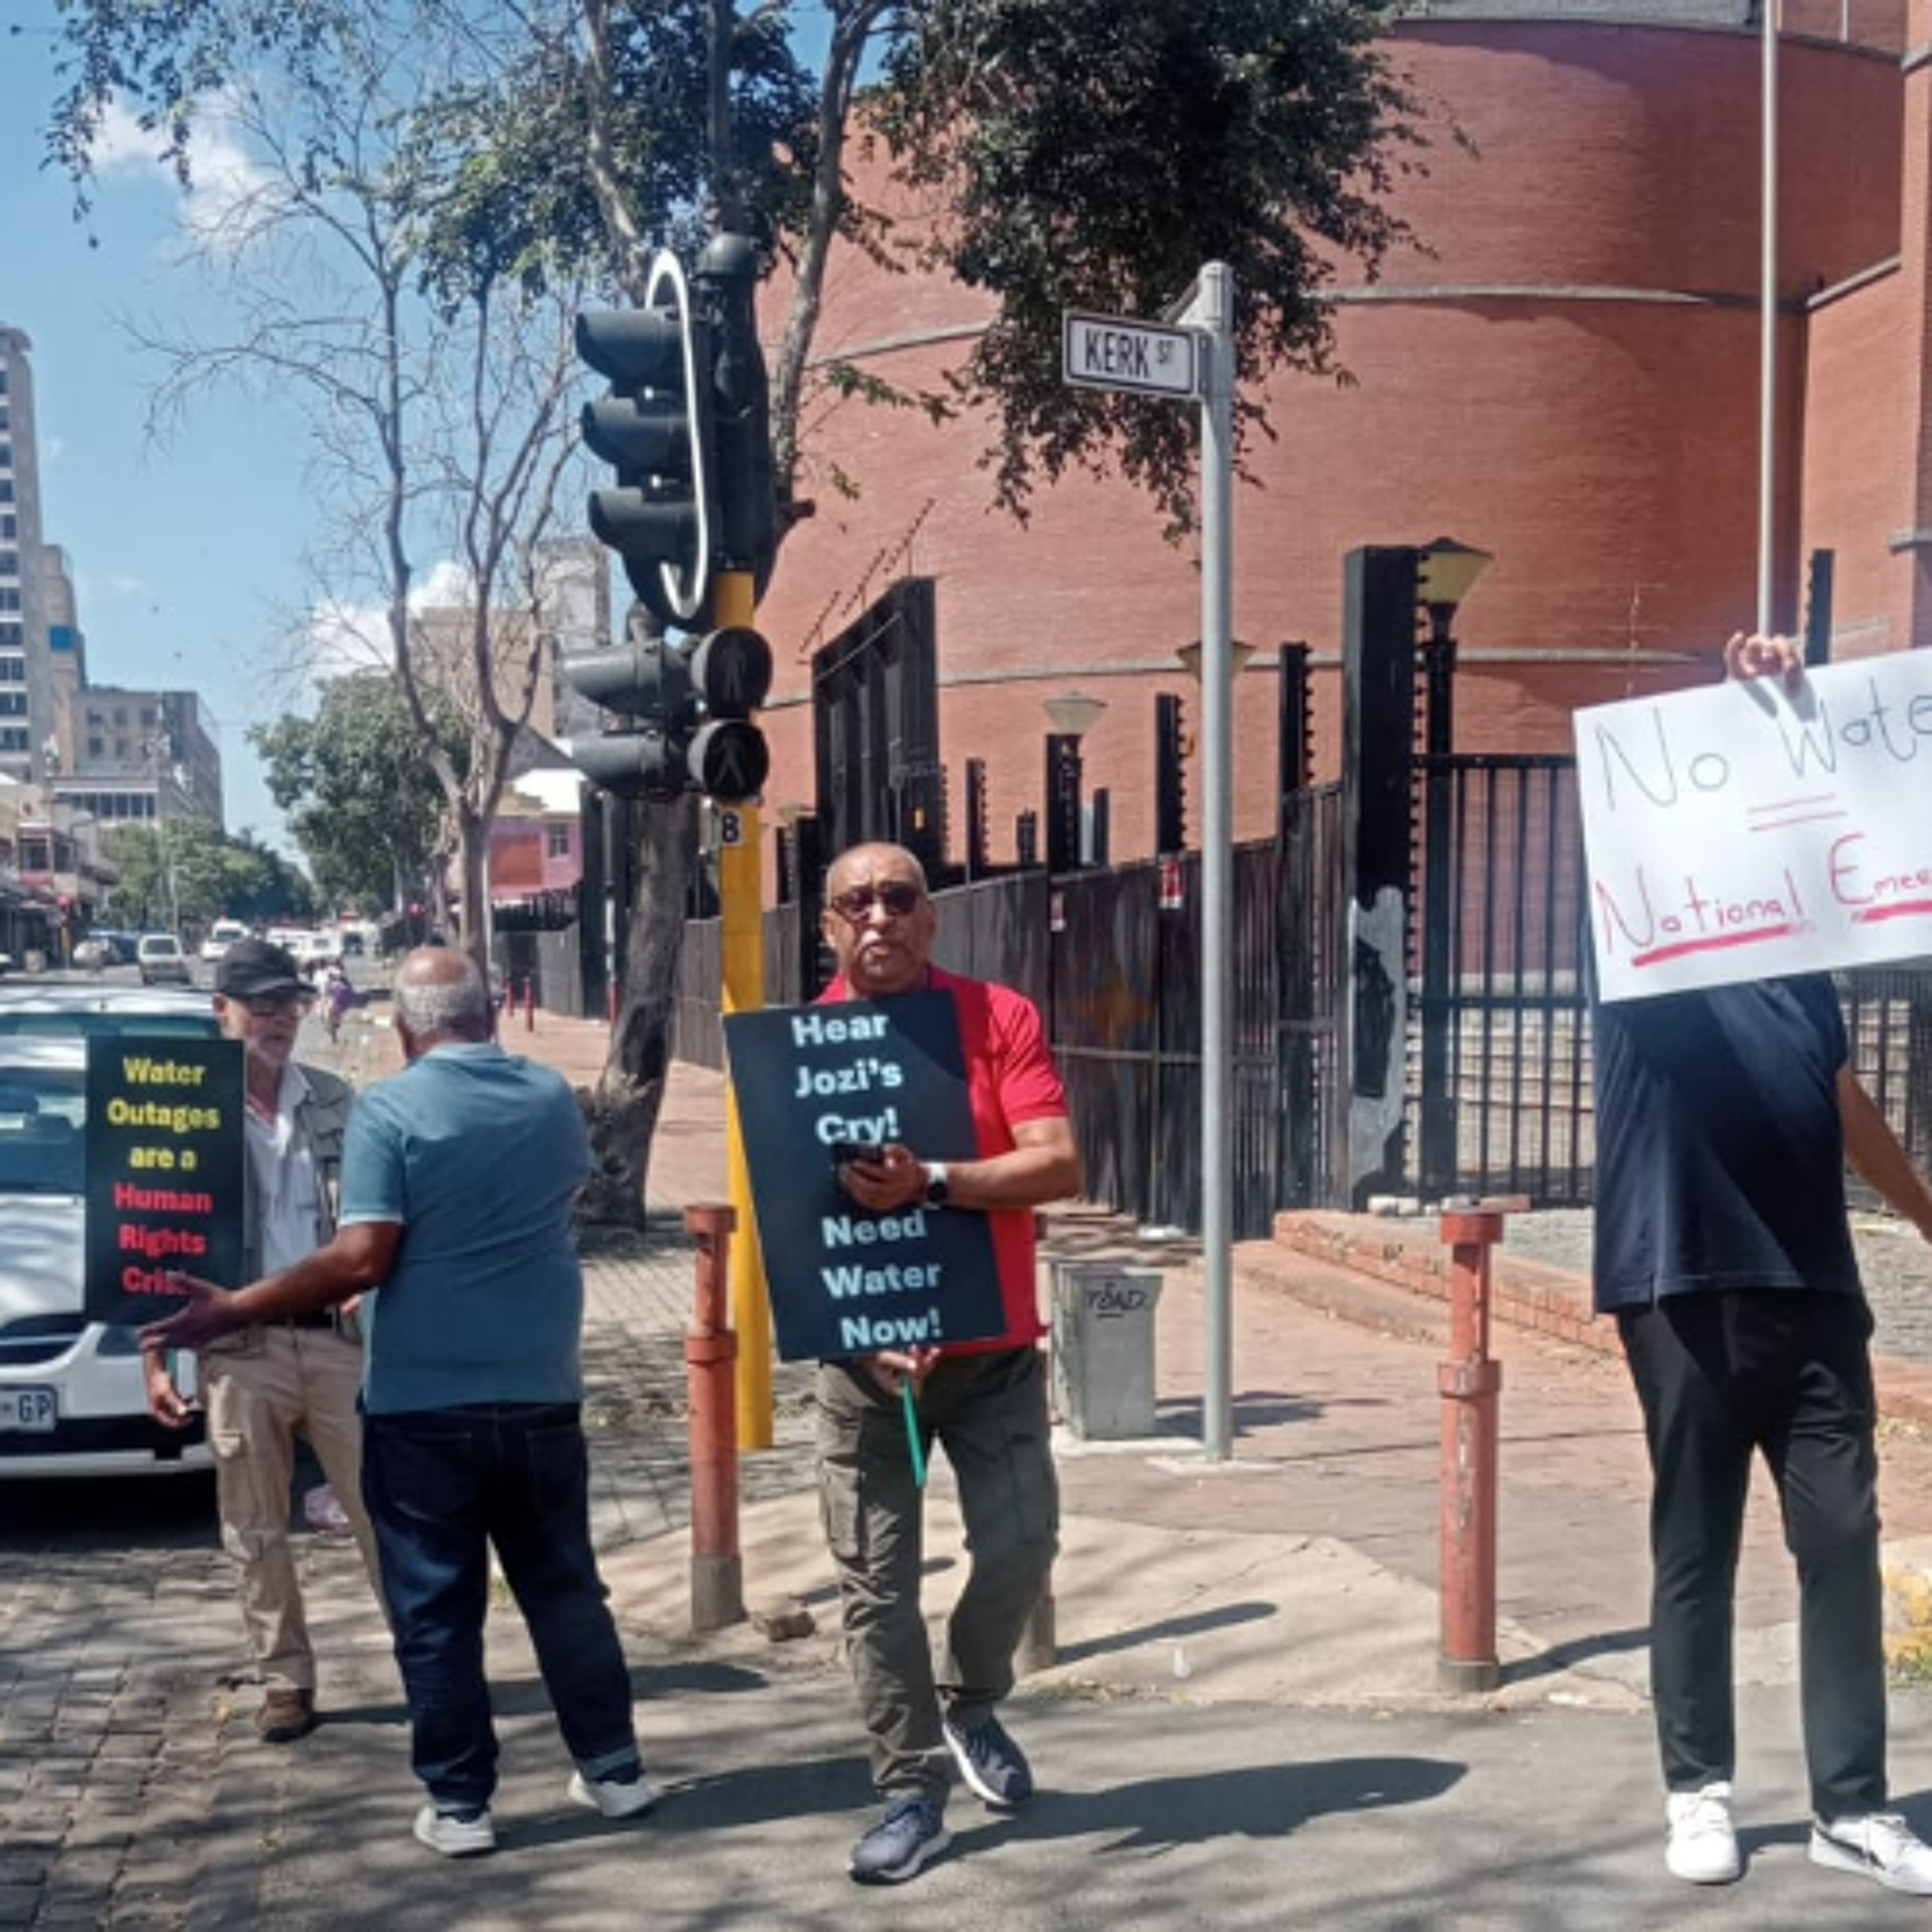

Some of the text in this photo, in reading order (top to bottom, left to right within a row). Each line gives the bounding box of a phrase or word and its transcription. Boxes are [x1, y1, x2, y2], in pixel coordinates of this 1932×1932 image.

[1085, 327, 1150, 379] KERK
[1595, 706, 1731, 812] No
[791, 1012, 889, 1048] Hear
[122, 1056, 206, 1085] Water
[795, 1057, 904, 1098] Jozi's
[107, 1098, 221, 1133] Outages
[815, 1106, 900, 1146] Cry!
[130, 1146, 197, 1170] are a
[113, 1181, 213, 1213] Human
[118, 1223, 207, 1258] Rights
[820, 1208, 927, 1248] Need
[819, 1263, 942, 1299] Water
[840, 1306, 943, 1349] Now!
[19, 1394, 52, 1423] GP
